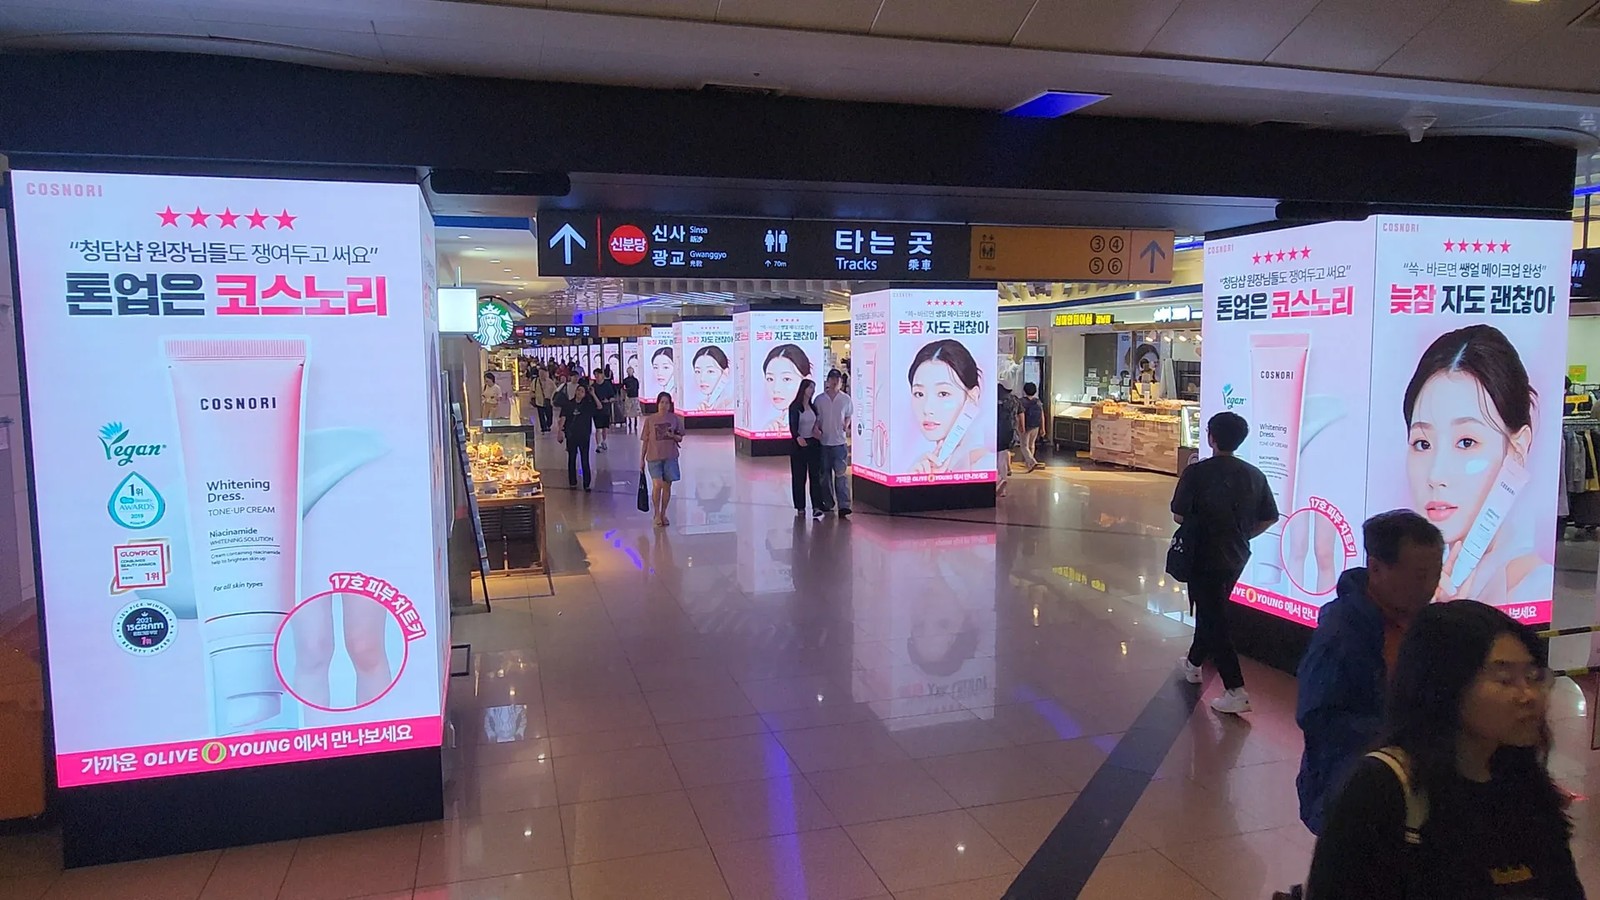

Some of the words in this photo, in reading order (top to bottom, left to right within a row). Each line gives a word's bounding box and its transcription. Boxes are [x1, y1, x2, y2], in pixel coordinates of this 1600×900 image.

[26, 182, 102, 198] COSNORI
[652, 224, 685, 243] 신사
[689, 225, 709, 234] Sinsa
[1382, 222, 1420, 232] COSNORI
[610, 237, 647, 252] 신분당
[835, 229, 895, 255] 타는
[908, 231, 933, 255] 곳
[146, 241, 249, 265] 원장님들도
[251, 243, 329, 265] 쟁여두고
[652, 249, 685, 267] 광교
[689, 250, 728, 260] Gwanggyo
[835, 257, 878, 271] Tracks
[1426, 262, 1457, 278] 바르면
[1459, 262, 1480, 278] 쌩얼
[1481, 262, 1521, 278] 메이크업
[1247, 270, 1289, 288] 원장님들도
[1289, 268, 1325, 284] 쟁여두고
[66, 272, 206, 316] 톤업은
[215, 274, 388, 317] 코스노리
[1390, 283, 1437, 315] 늦잠
[1441, 284, 1486, 315] 자도
[1490, 284, 1556, 315] 괜찮아
[1216, 292, 1268, 322] 톤업은
[1271, 285, 1354, 319] 코스노리
[899, 320, 924, 335] 늦잠
[926, 320, 951, 335] 자도
[952, 320, 989, 335] 괜찮아
[774, 331, 793, 341] 자도
[1260, 370, 1294, 380] COSNORI
[200, 396, 277, 411] COSNORI
[128, 483, 144, 497] 1위
[206, 478, 271, 492] Whitening
[207, 492, 245, 503] Dress.
[120, 503, 155, 511] AWARDS
[207, 506, 245, 517] TONE-UP
[246, 505, 276, 514] CREAM
[1310, 497, 1328, 510] 17호
[1327, 505, 1344, 524] 피부
[209, 527, 258, 539] Niacinamide
[120, 549, 159, 558] GLOWPICK
[145, 571, 160, 581] 1위
[246, 581, 263, 589] types
[331, 575, 366, 591] 17호
[365, 579, 397, 602] 피부
[391, 596, 425, 640] 치트키
[1257, 594, 1284, 610] YOUNG
[1284, 602, 1301, 617] 에서
[80, 753, 137, 775] 가까운
[143, 747, 198, 767] OLIVE
[228, 738, 291, 758] YOUNG
[294, 733, 328, 753] 에서
[331, 724, 413, 748] 만나보세요
